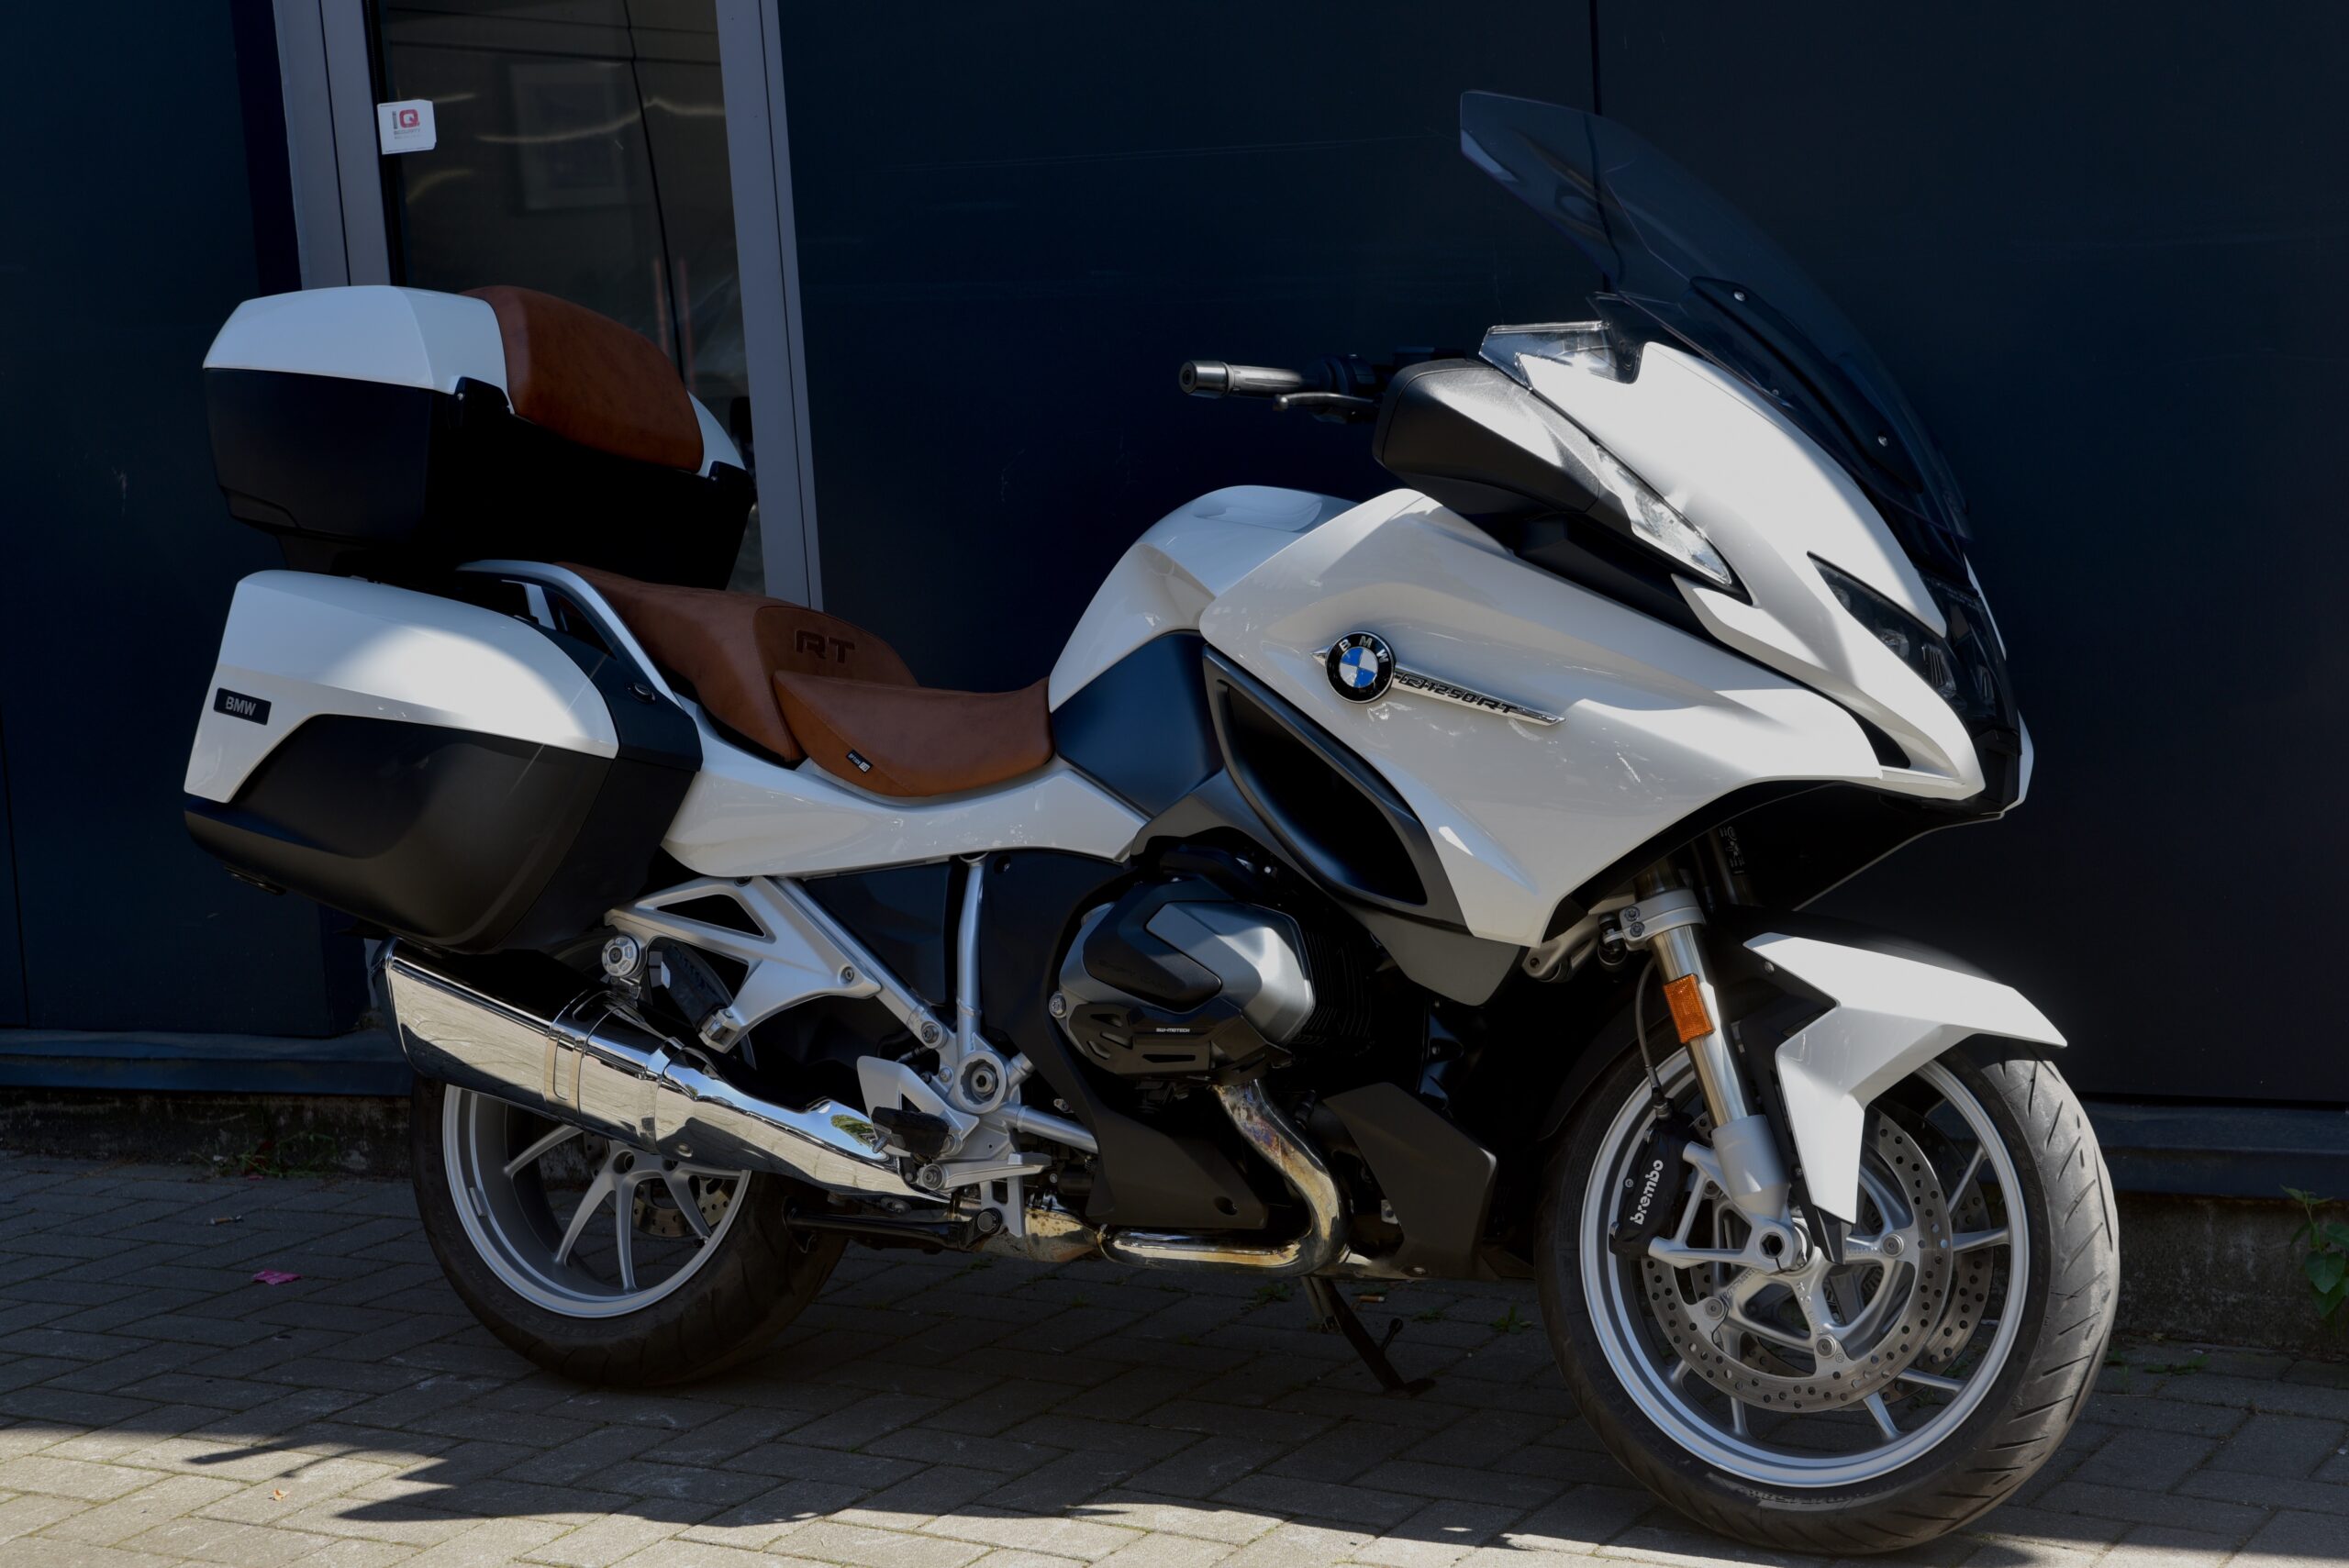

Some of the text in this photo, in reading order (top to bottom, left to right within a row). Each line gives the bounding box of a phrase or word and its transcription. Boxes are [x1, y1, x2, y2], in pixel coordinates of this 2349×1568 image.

[795, 629, 855, 663] RT
[1340, 636, 1390, 664] BMW
[225, 695, 257, 717] BMW
[1630, 1159, 1664, 1225] brembo
